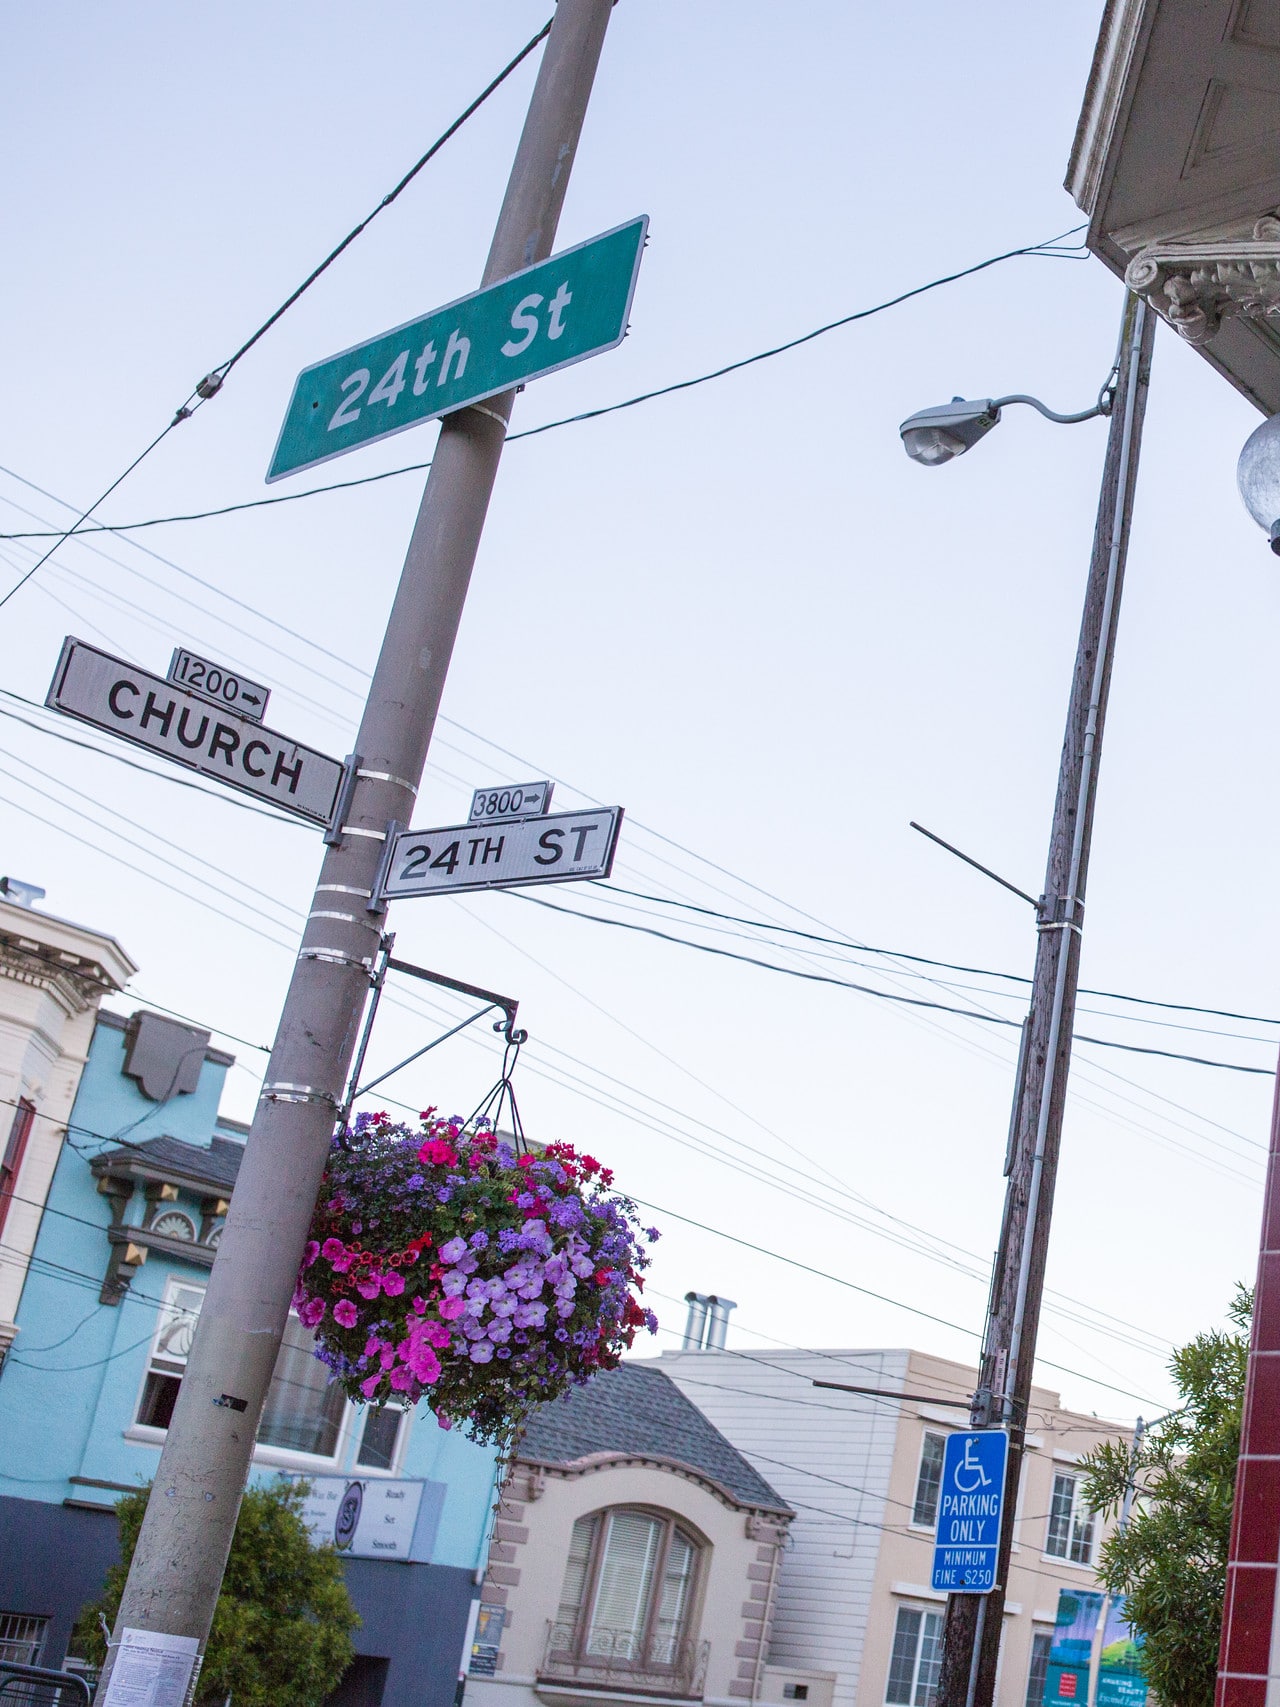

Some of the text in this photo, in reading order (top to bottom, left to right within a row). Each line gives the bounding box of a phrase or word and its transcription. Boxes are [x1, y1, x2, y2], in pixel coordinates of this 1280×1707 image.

[327, 280, 574, 432] 24th St
[177, 656, 240, 702] 1200
[107, 679, 304, 795] CHURCH
[473, 788, 524, 817] 3800
[399, 824, 599, 880] 24TH ST
[942, 1494, 999, 1516] PARKING
[950, 1520, 986, 1542] ONLY
[943, 1551, 987, 1566] MINIMUM
[934, 1569, 992, 1585] FINE $250
